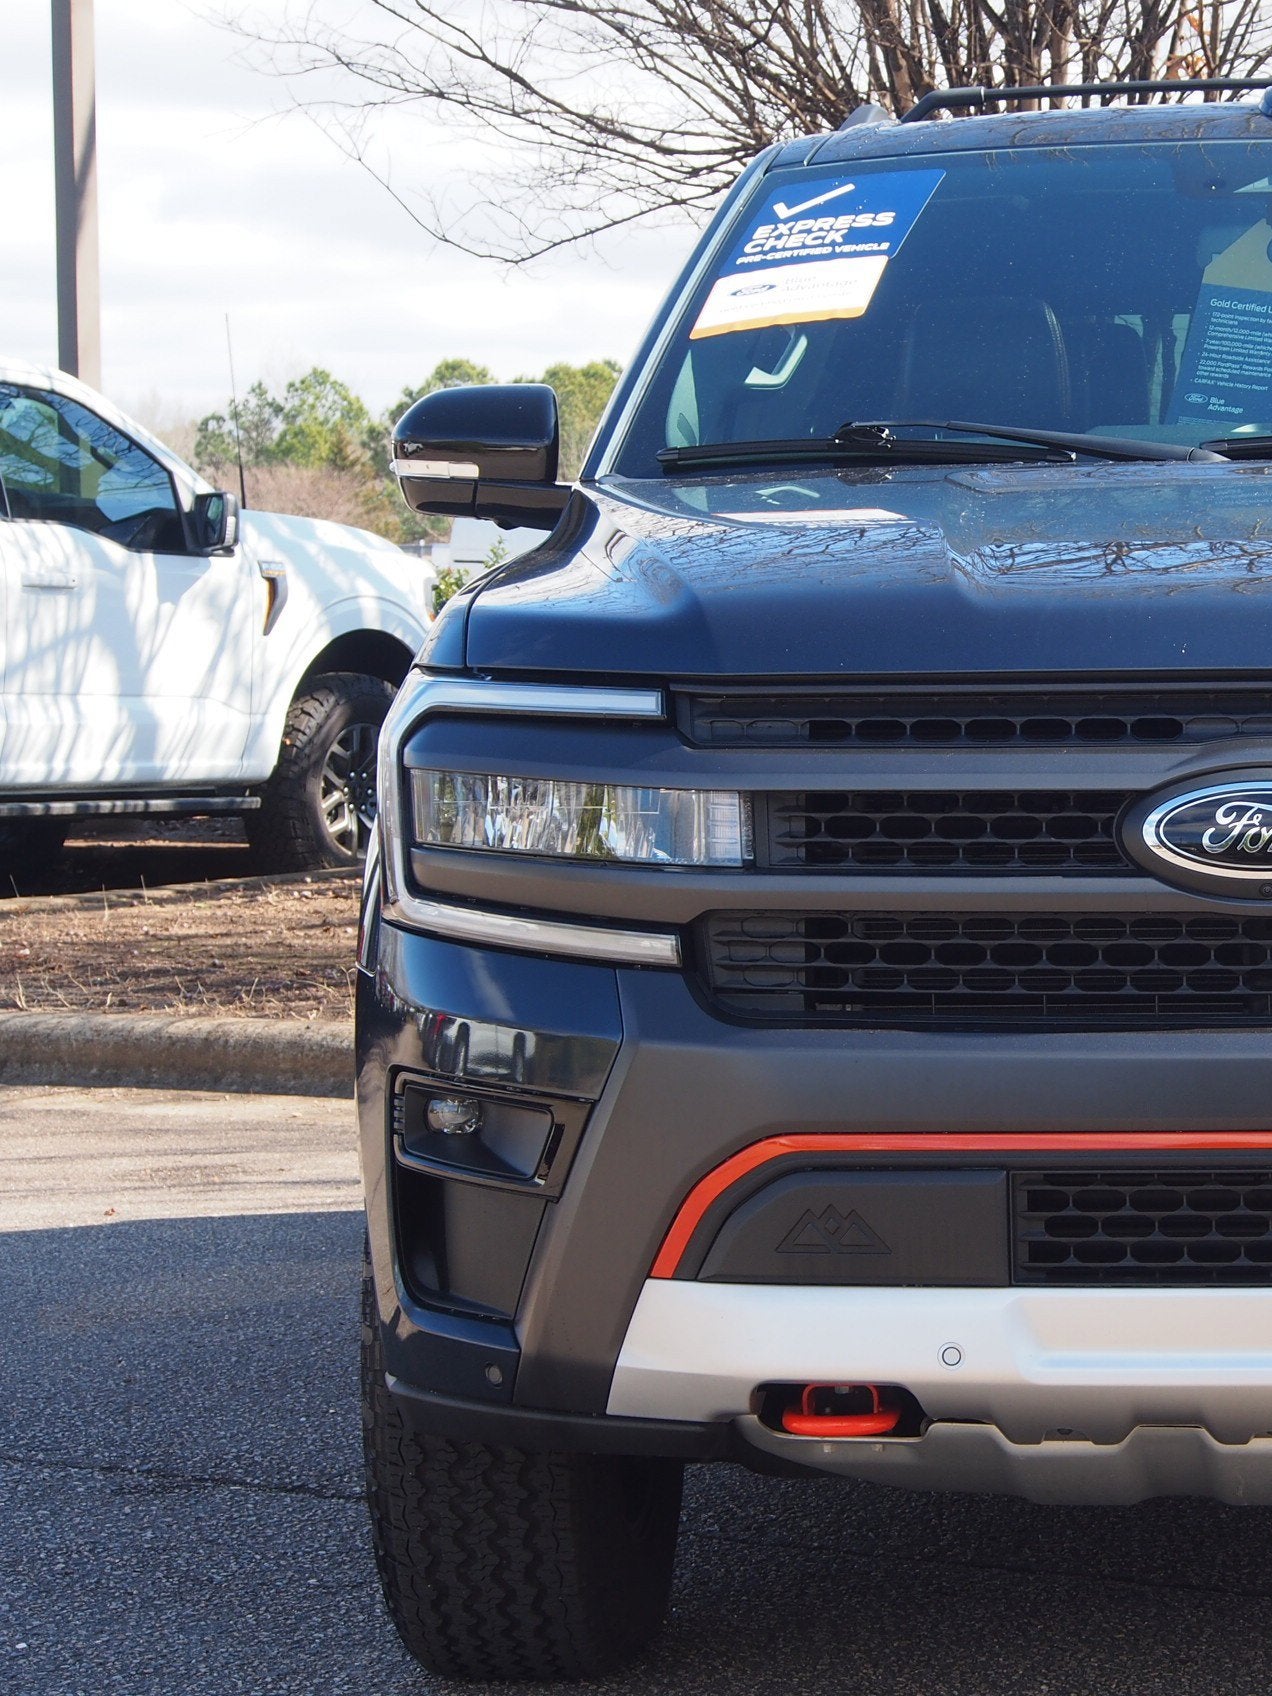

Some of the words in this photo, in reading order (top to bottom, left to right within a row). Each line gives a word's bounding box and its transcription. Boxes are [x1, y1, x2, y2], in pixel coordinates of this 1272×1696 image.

[752, 212, 896, 240] EXPRESS
[743, 229, 849, 254] CHECK
[736, 246, 833, 265] PRE-CERTIFIED
[834, 242, 890, 253] VEHICLE
[1210, 298, 1231, 308] Gold
[1231, 301, 1267, 313] Certified
[1210, 317, 1239, 325] technicians
[1207, 330, 1244, 340] Comprehensive
[1204, 343, 1230, 351] Powertrain
[1222, 353, 1244, 361] Roadside
[1244, 356, 1271, 364] Assistance
[1215, 367, 1241, 375] scheduled
[1234, 382, 1251, 390] History
[1209, 397, 1225, 405] Blue
[1207, 404, 1244, 414] Advantage
